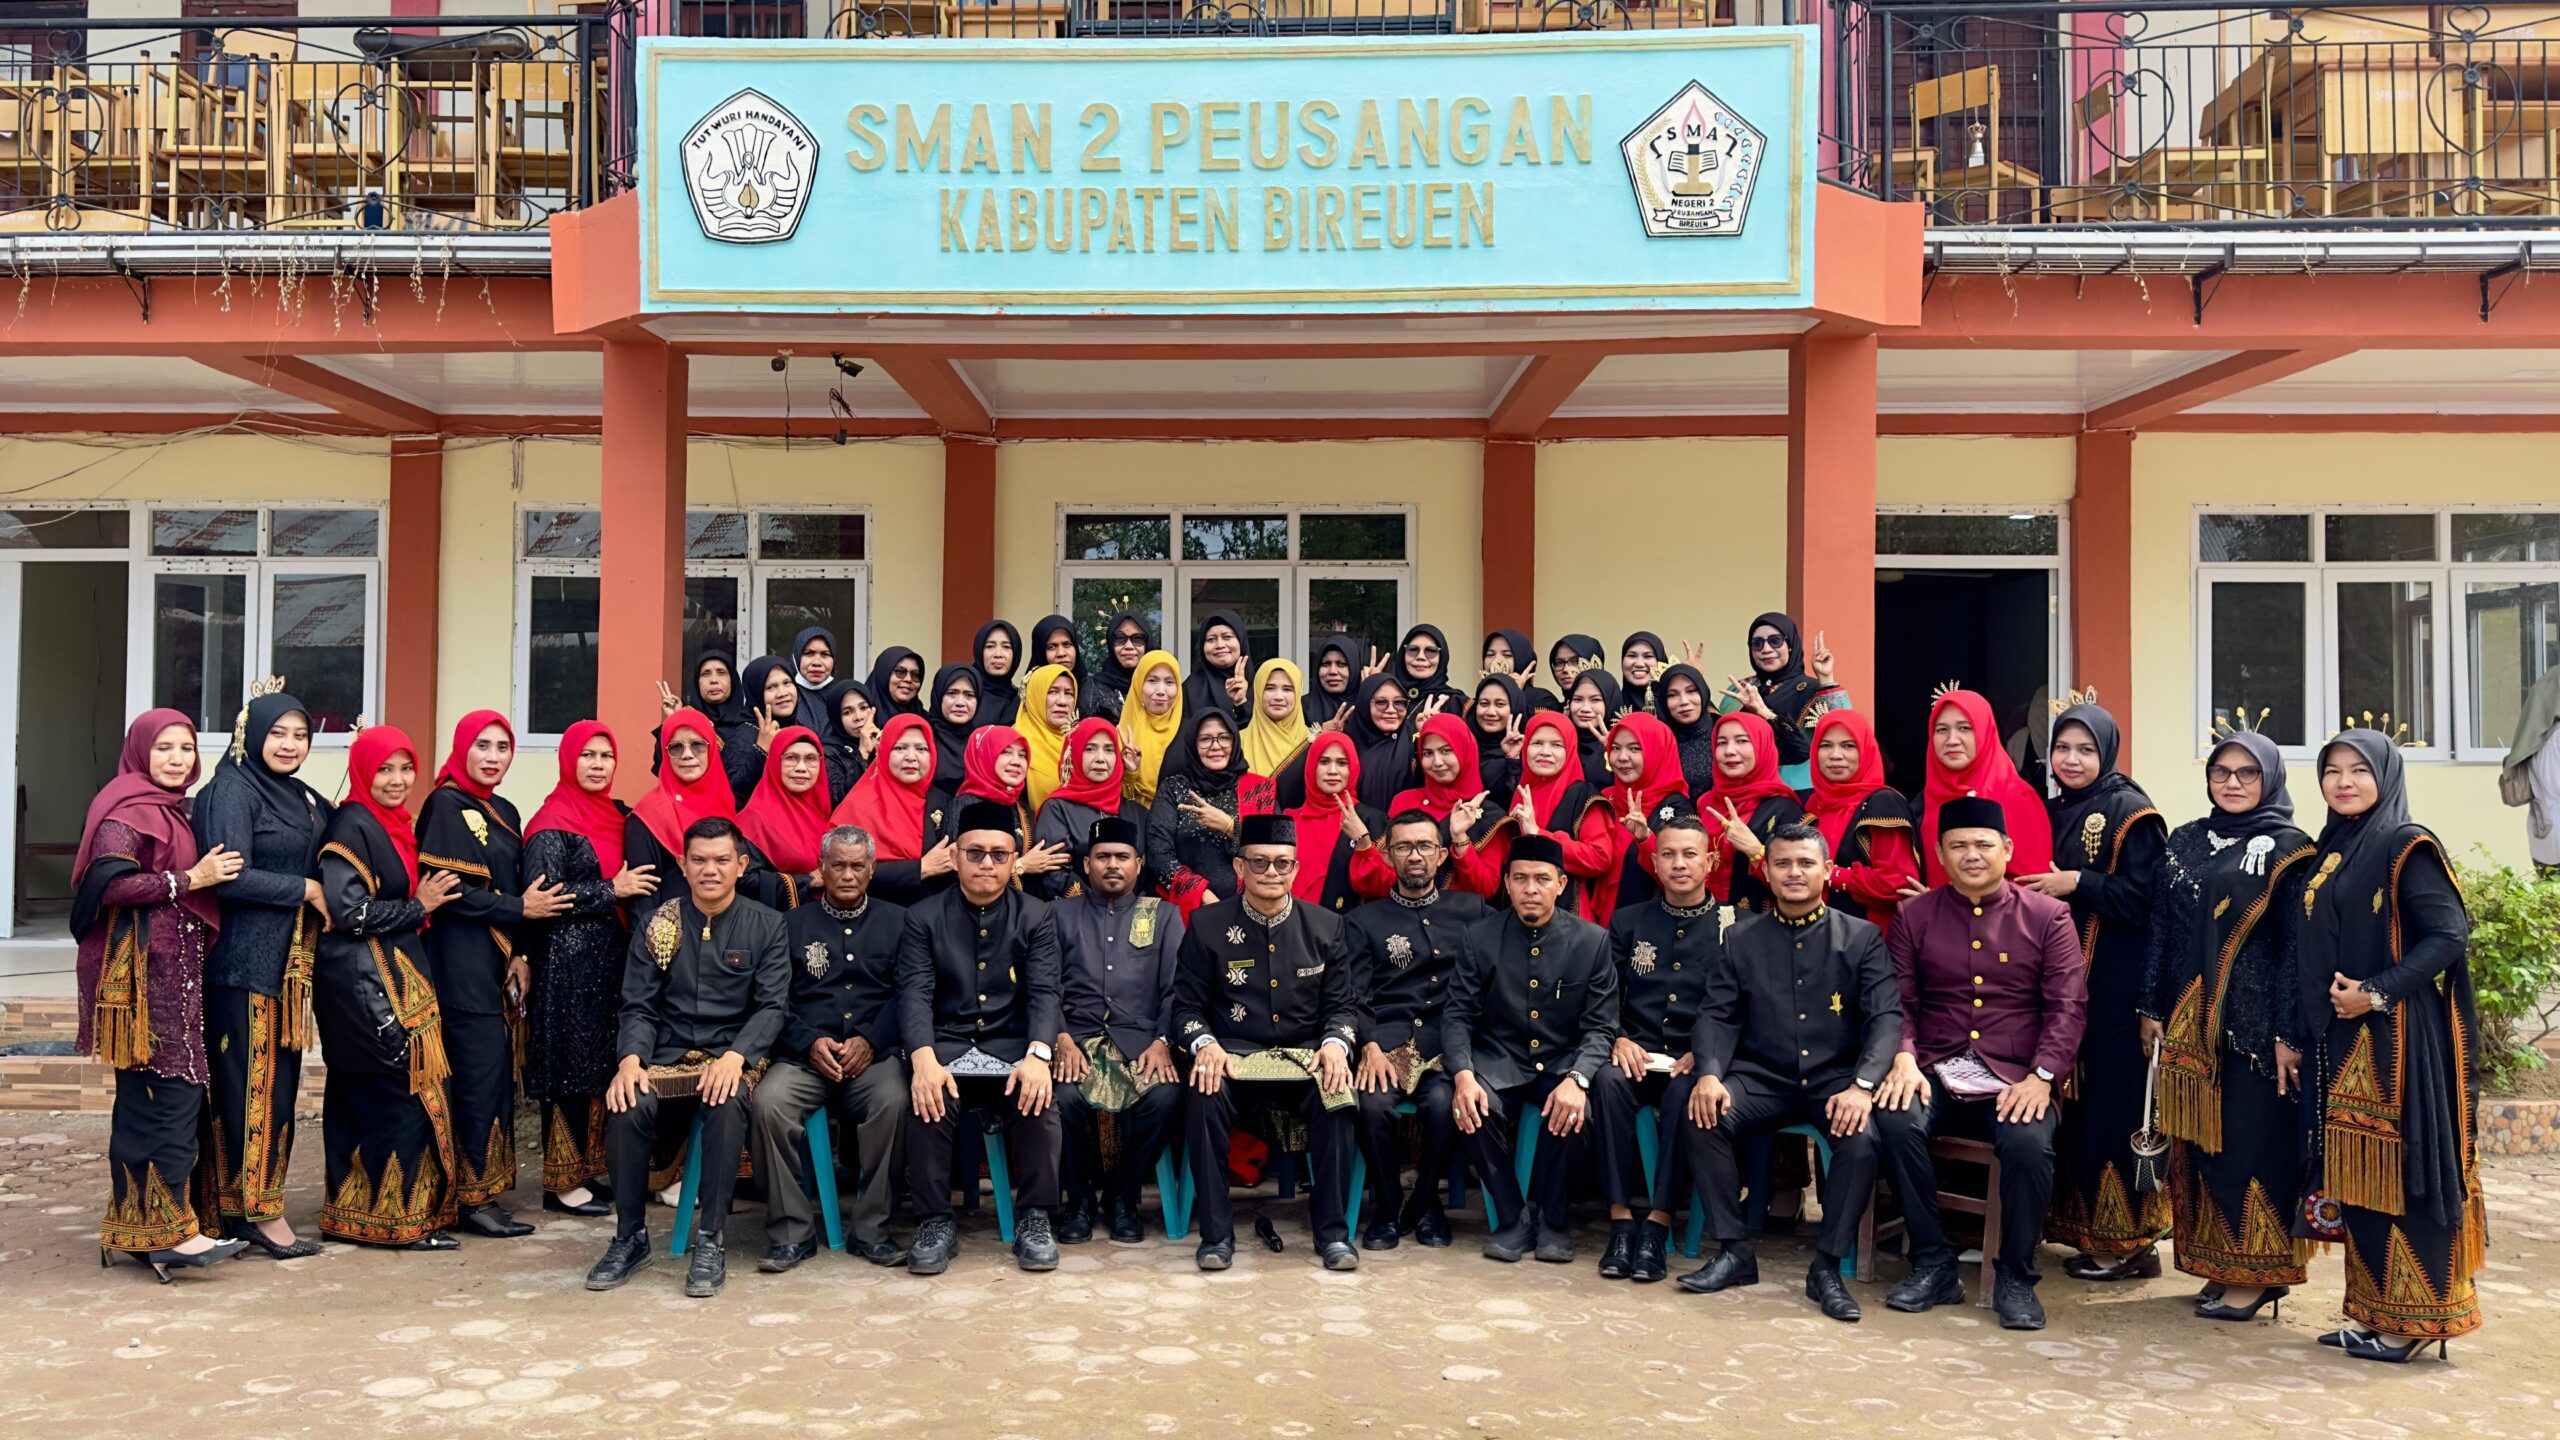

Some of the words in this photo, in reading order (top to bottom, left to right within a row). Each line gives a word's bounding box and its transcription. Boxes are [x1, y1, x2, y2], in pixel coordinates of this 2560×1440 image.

[692, 129, 711, 149] TUT
[711, 112, 741, 130] WURI
[746, 110, 807, 151] HANDAYANI
[845, 102, 1053, 174] SMAN
[1080, 102, 1123, 173] 2
[1149, 94, 1594, 174] PEUSANGAN
[939, 186, 1240, 254] KABUPATEN
[1263, 180, 1496, 252] BIREUEN
[1671, 198, 1706, 207] NEGERI
[1708, 198, 1715, 207] 2
